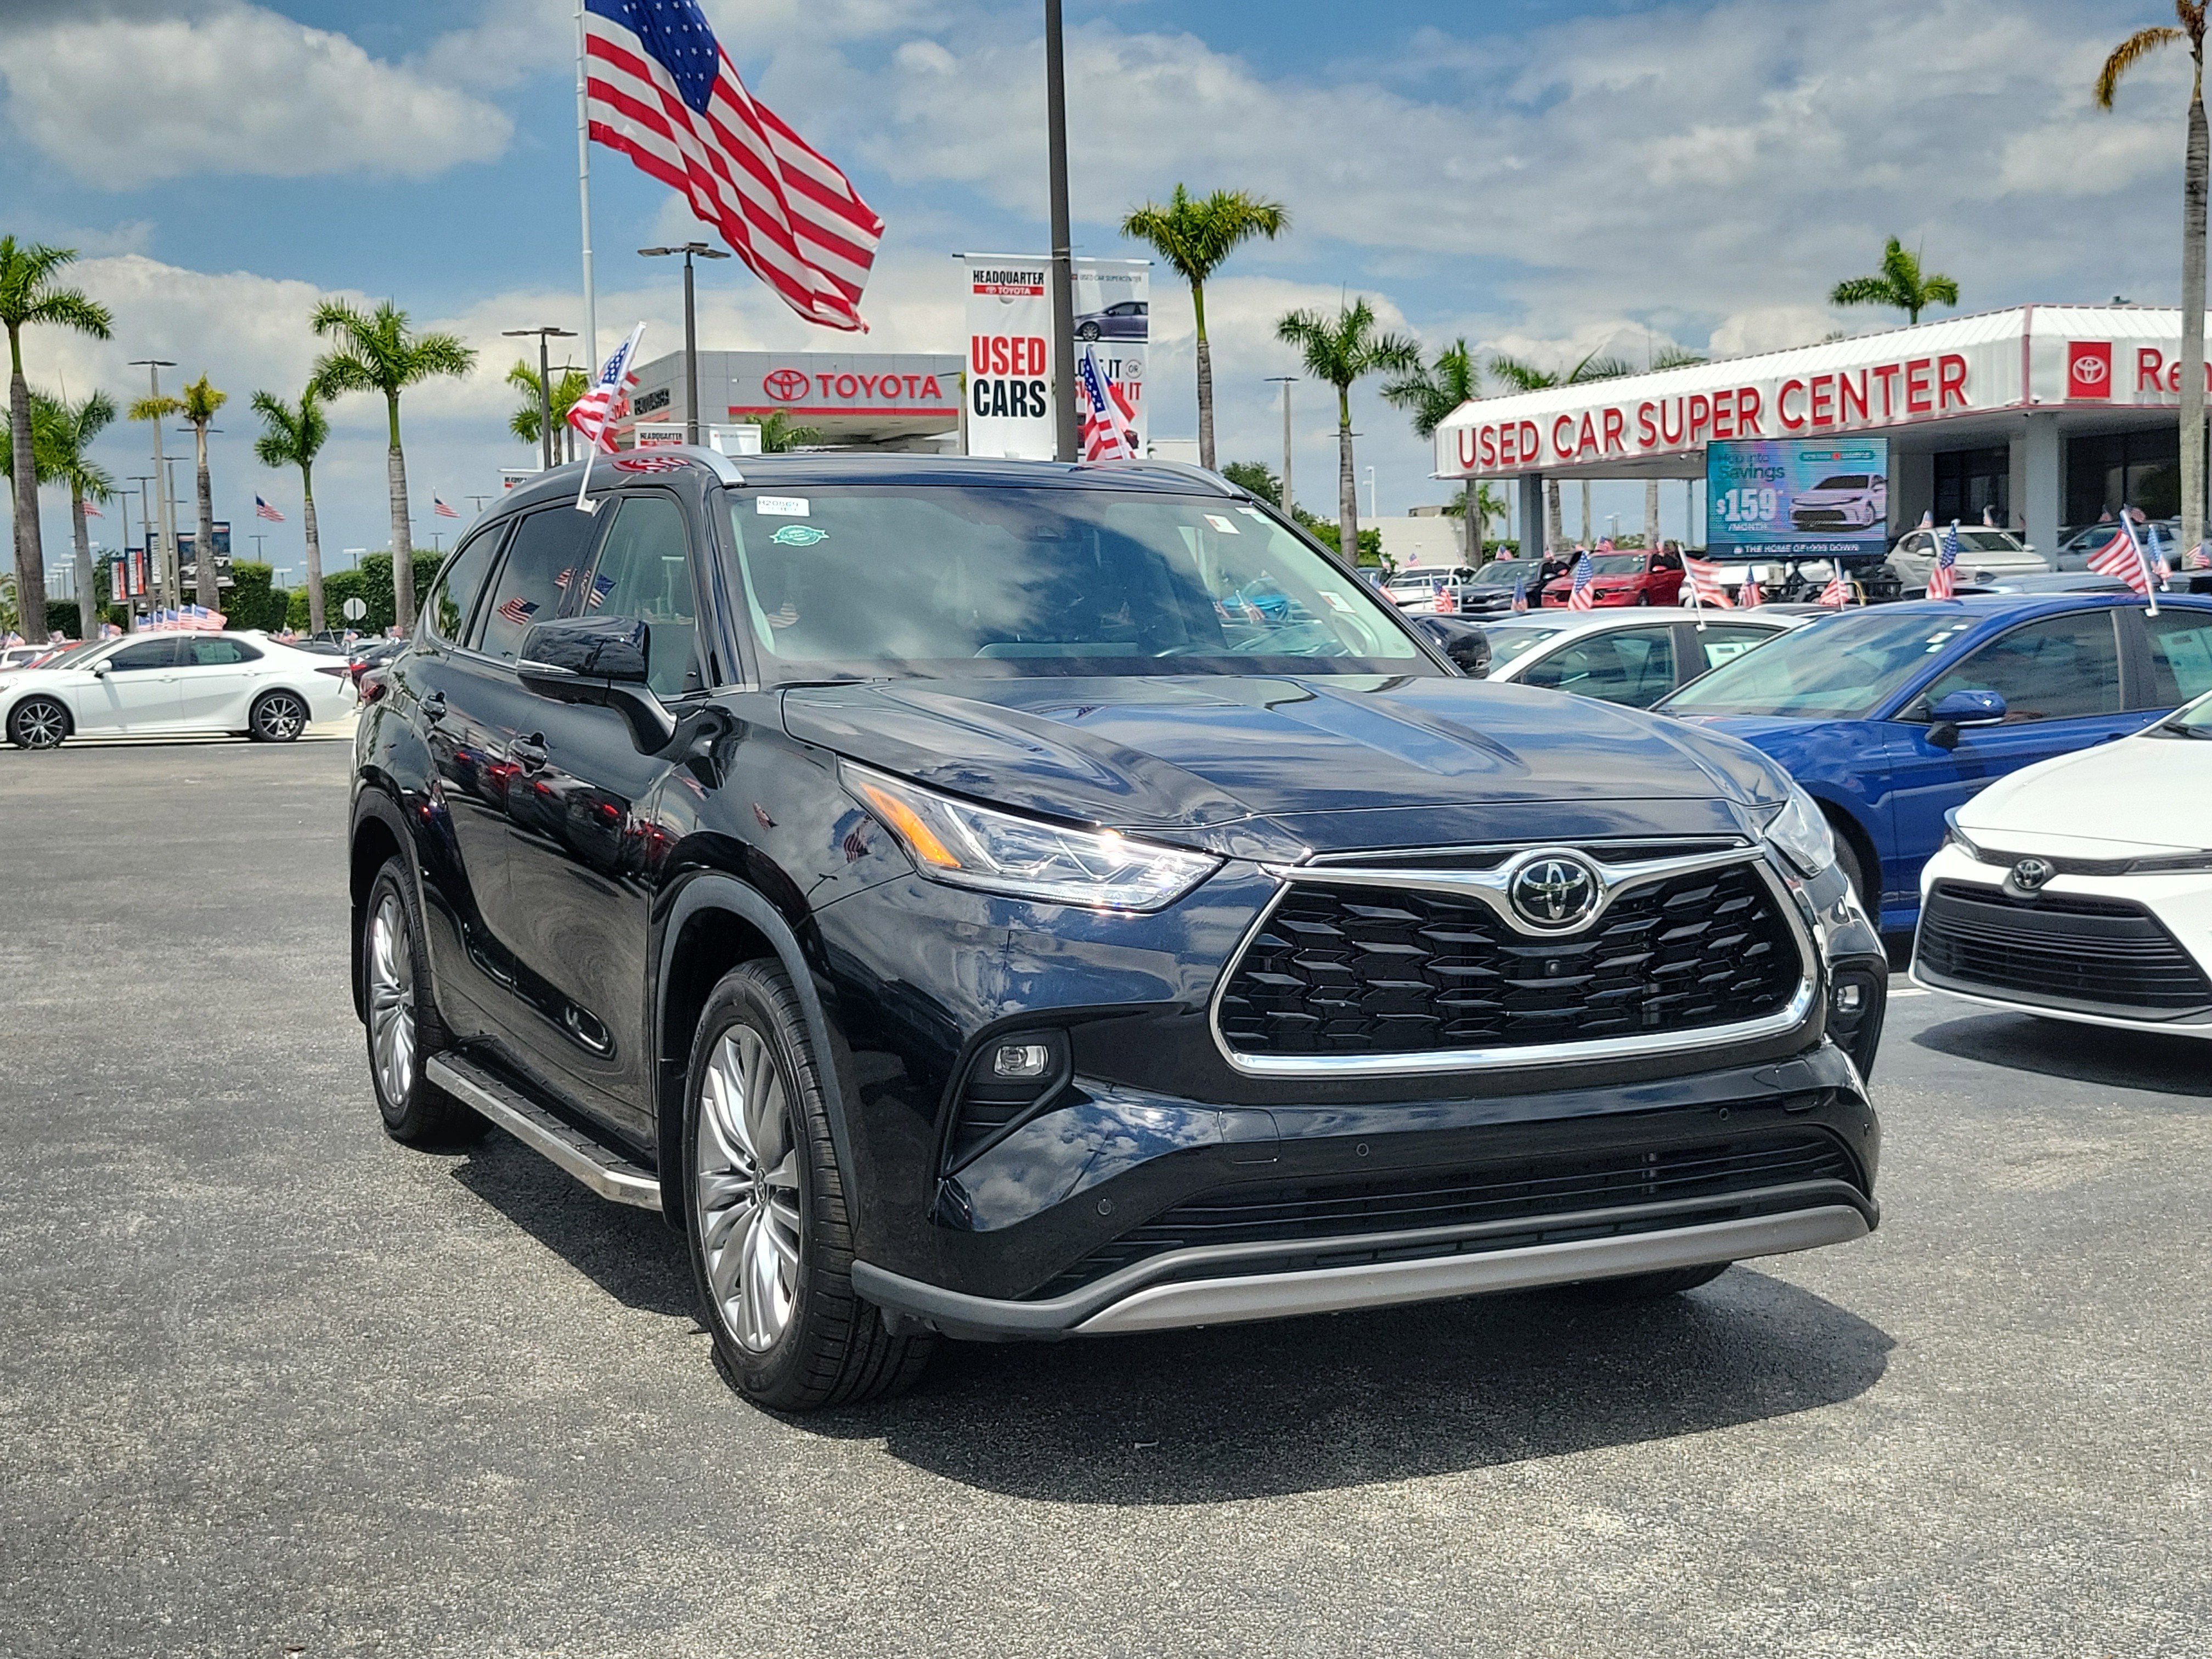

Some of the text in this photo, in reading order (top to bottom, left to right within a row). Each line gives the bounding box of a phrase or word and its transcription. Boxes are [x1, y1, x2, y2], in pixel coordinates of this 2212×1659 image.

[973, 270, 1044, 285] HEADQUARTER
[972, 335, 1046, 376] USED
[815, 374, 943, 399] TOYOTA
[973, 379, 1047, 418] CARS
[1458, 353, 1968, 470] USED CAR SUPER CENTER
[1720, 464, 1785, 482] Savings
